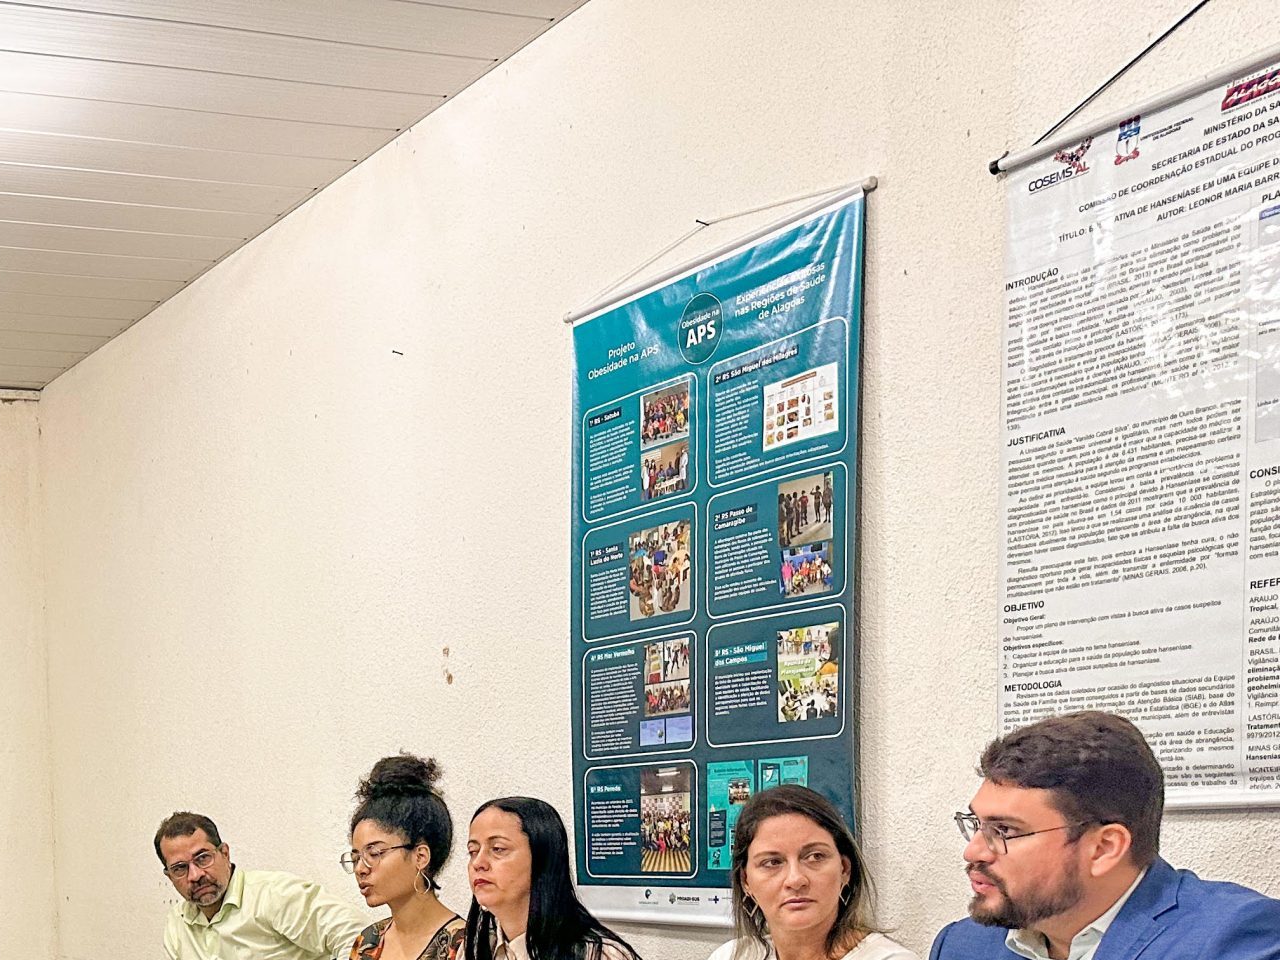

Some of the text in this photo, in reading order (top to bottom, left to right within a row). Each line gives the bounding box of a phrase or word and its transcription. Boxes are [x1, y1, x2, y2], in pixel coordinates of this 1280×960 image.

[1203, 110, 1252, 138] MINISTÉRIO
[1254, 105, 1267, 117] DA
[1151, 144, 1200, 172] SECRETARIA
[1202, 139, 1214, 151] DE
[1216, 125, 1250, 147] ESTADO
[1252, 120, 1265, 132] DA
[1028, 169, 1073, 191] COSEMS
[1118, 187, 1128, 197] DE
[1131, 161, 1192, 193] COORDENAÇÃO
[1195, 144, 1237, 169] ESTADUAL
[1240, 139, 1253, 151] DO
[1114, 207, 1136, 223] ATIVA
[1137, 203, 1148, 214] DE
[1150, 182, 1200, 210] HANSENÍASE
[1202, 180, 1214, 190] EM
[1217, 172, 1235, 186] UMA
[1238, 159, 1270, 178] EQUIPE
[1156, 204, 1186, 221] AUTOR:
[1188, 191, 1222, 210] LEONOR
[1224, 181, 1252, 197] MARIA
[1005, 267, 1058, 291] INTRODUÇÃO
[735, 305, 750, 318] nas
[751, 290, 785, 311] Regiões
[758, 295, 805, 320] de Alagoas
[681, 308, 720, 329] Obesidade na
[686, 320, 716, 348] APS
[588, 344, 659, 380] Obesidade na APS
[608, 341, 635, 360] Projeto
[742, 361, 761, 373] Miguel
[1007, 427, 1065, 447] JUSTIFICATIVA
[715, 517, 746, 530] Camaragibe
[1003, 601, 1044, 613] OBJETIVO
[733, 645, 744, 654] São
[744, 642, 765, 653] Miguel
[1004, 680, 1062, 693] METODOLOGIA
